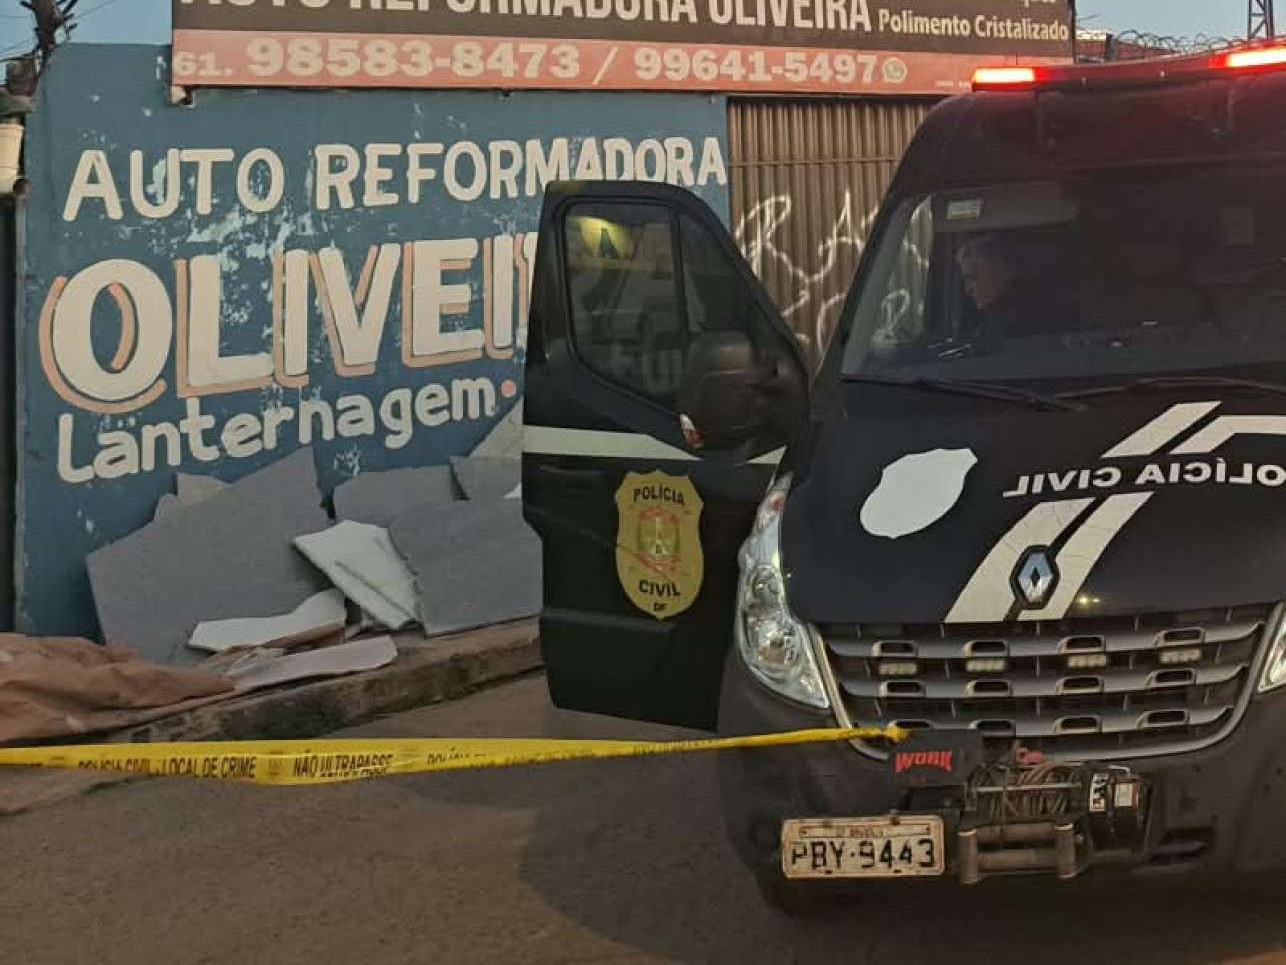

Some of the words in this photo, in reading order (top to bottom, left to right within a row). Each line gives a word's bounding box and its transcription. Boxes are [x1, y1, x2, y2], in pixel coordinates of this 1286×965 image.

[877, 8, 971, 37] Polimento
[974, 15, 1070, 41] Cristalizado
[173, 50, 233, 78] 61.
[246, 36, 581, 80] 98583-8473
[634, 46, 879, 84] 99641-5497
[62, 147, 285, 222] AUTO
[314, 137, 728, 211] REFORMADORA
[40, 231, 539, 413] OLIVEI
[57, 376, 497, 484] Lanternagem
[638, 578, 682, 598] CIVIL
[203, 755, 218, 779] DE
[221, 755, 258, 779] CRIME
